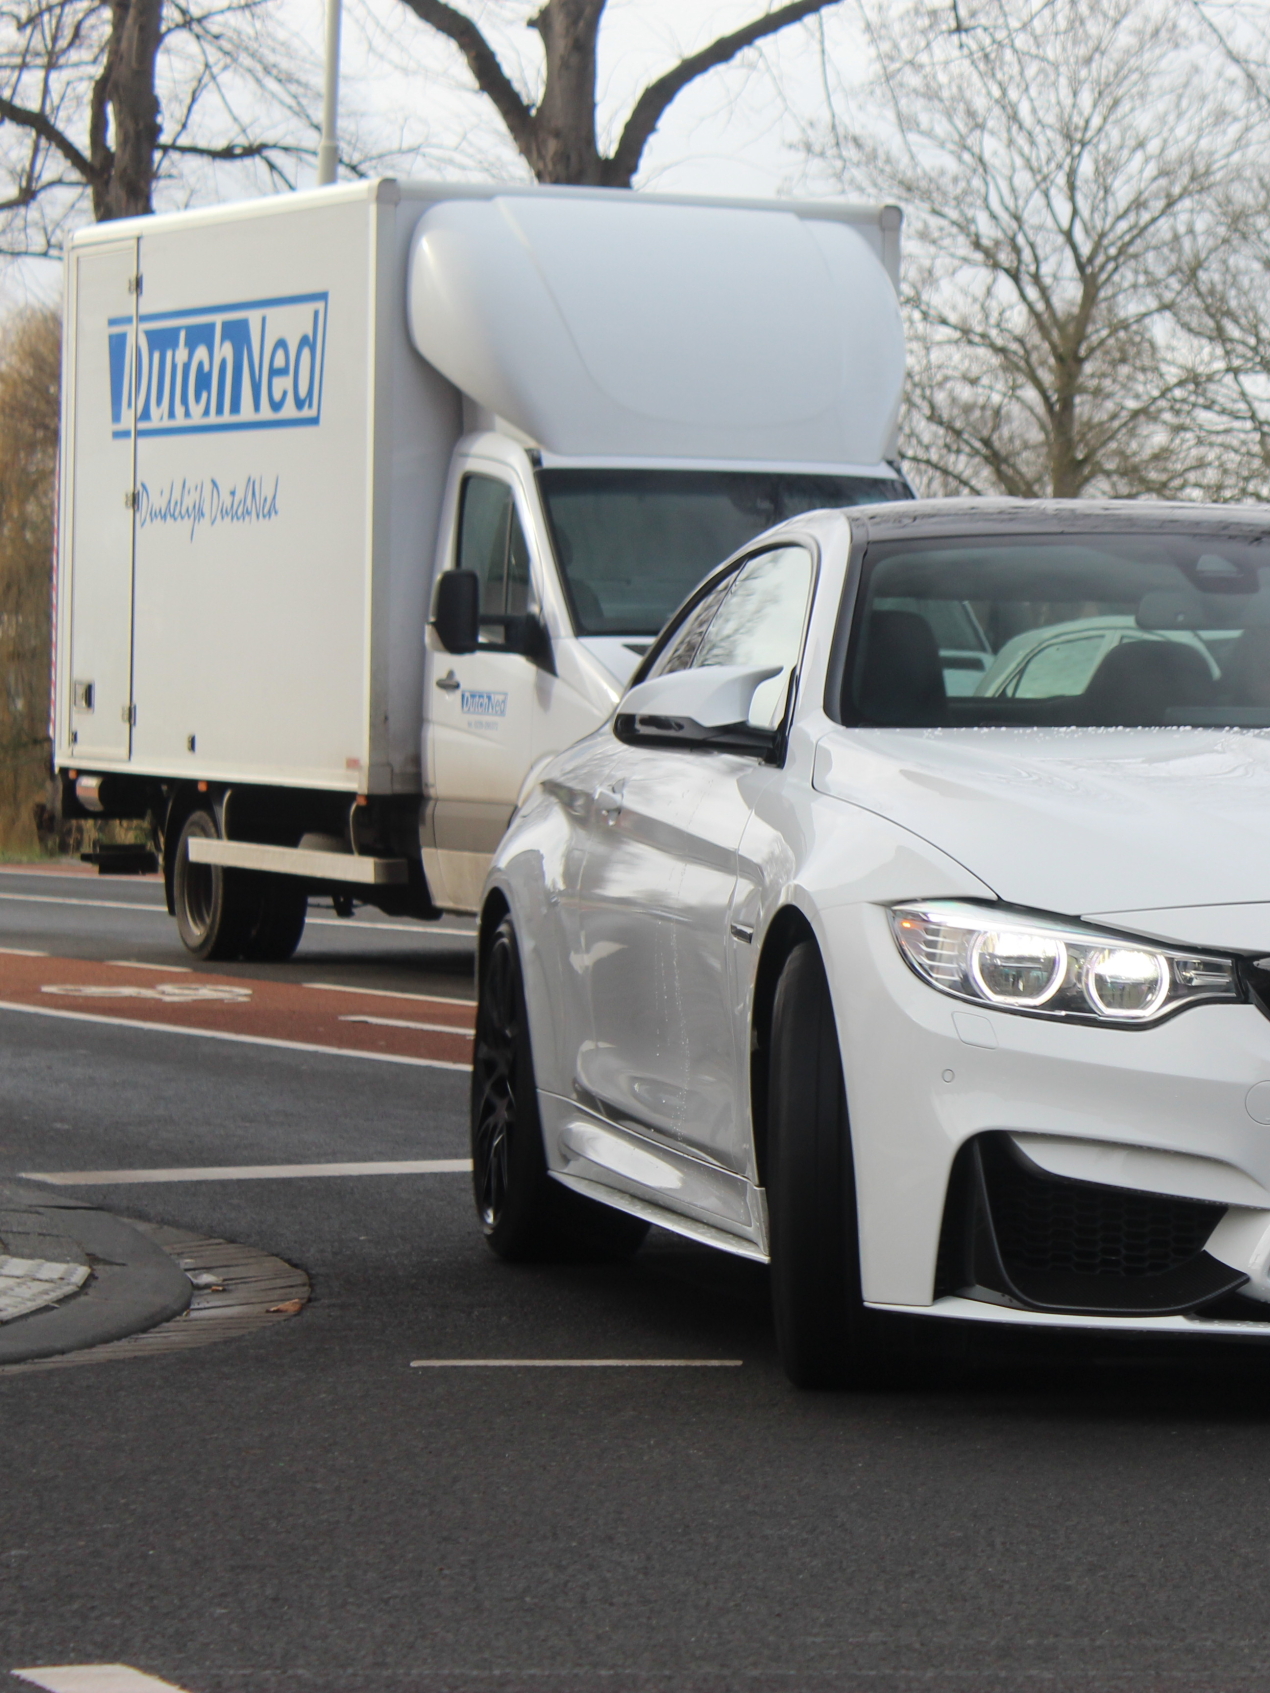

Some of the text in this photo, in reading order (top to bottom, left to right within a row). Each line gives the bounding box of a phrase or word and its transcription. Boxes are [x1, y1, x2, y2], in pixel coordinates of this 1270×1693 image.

[120, 308, 320, 423] DutchNed
[140, 474, 279, 543] Duidelijk DutchNed
[463, 691, 506, 715] DutchNed
